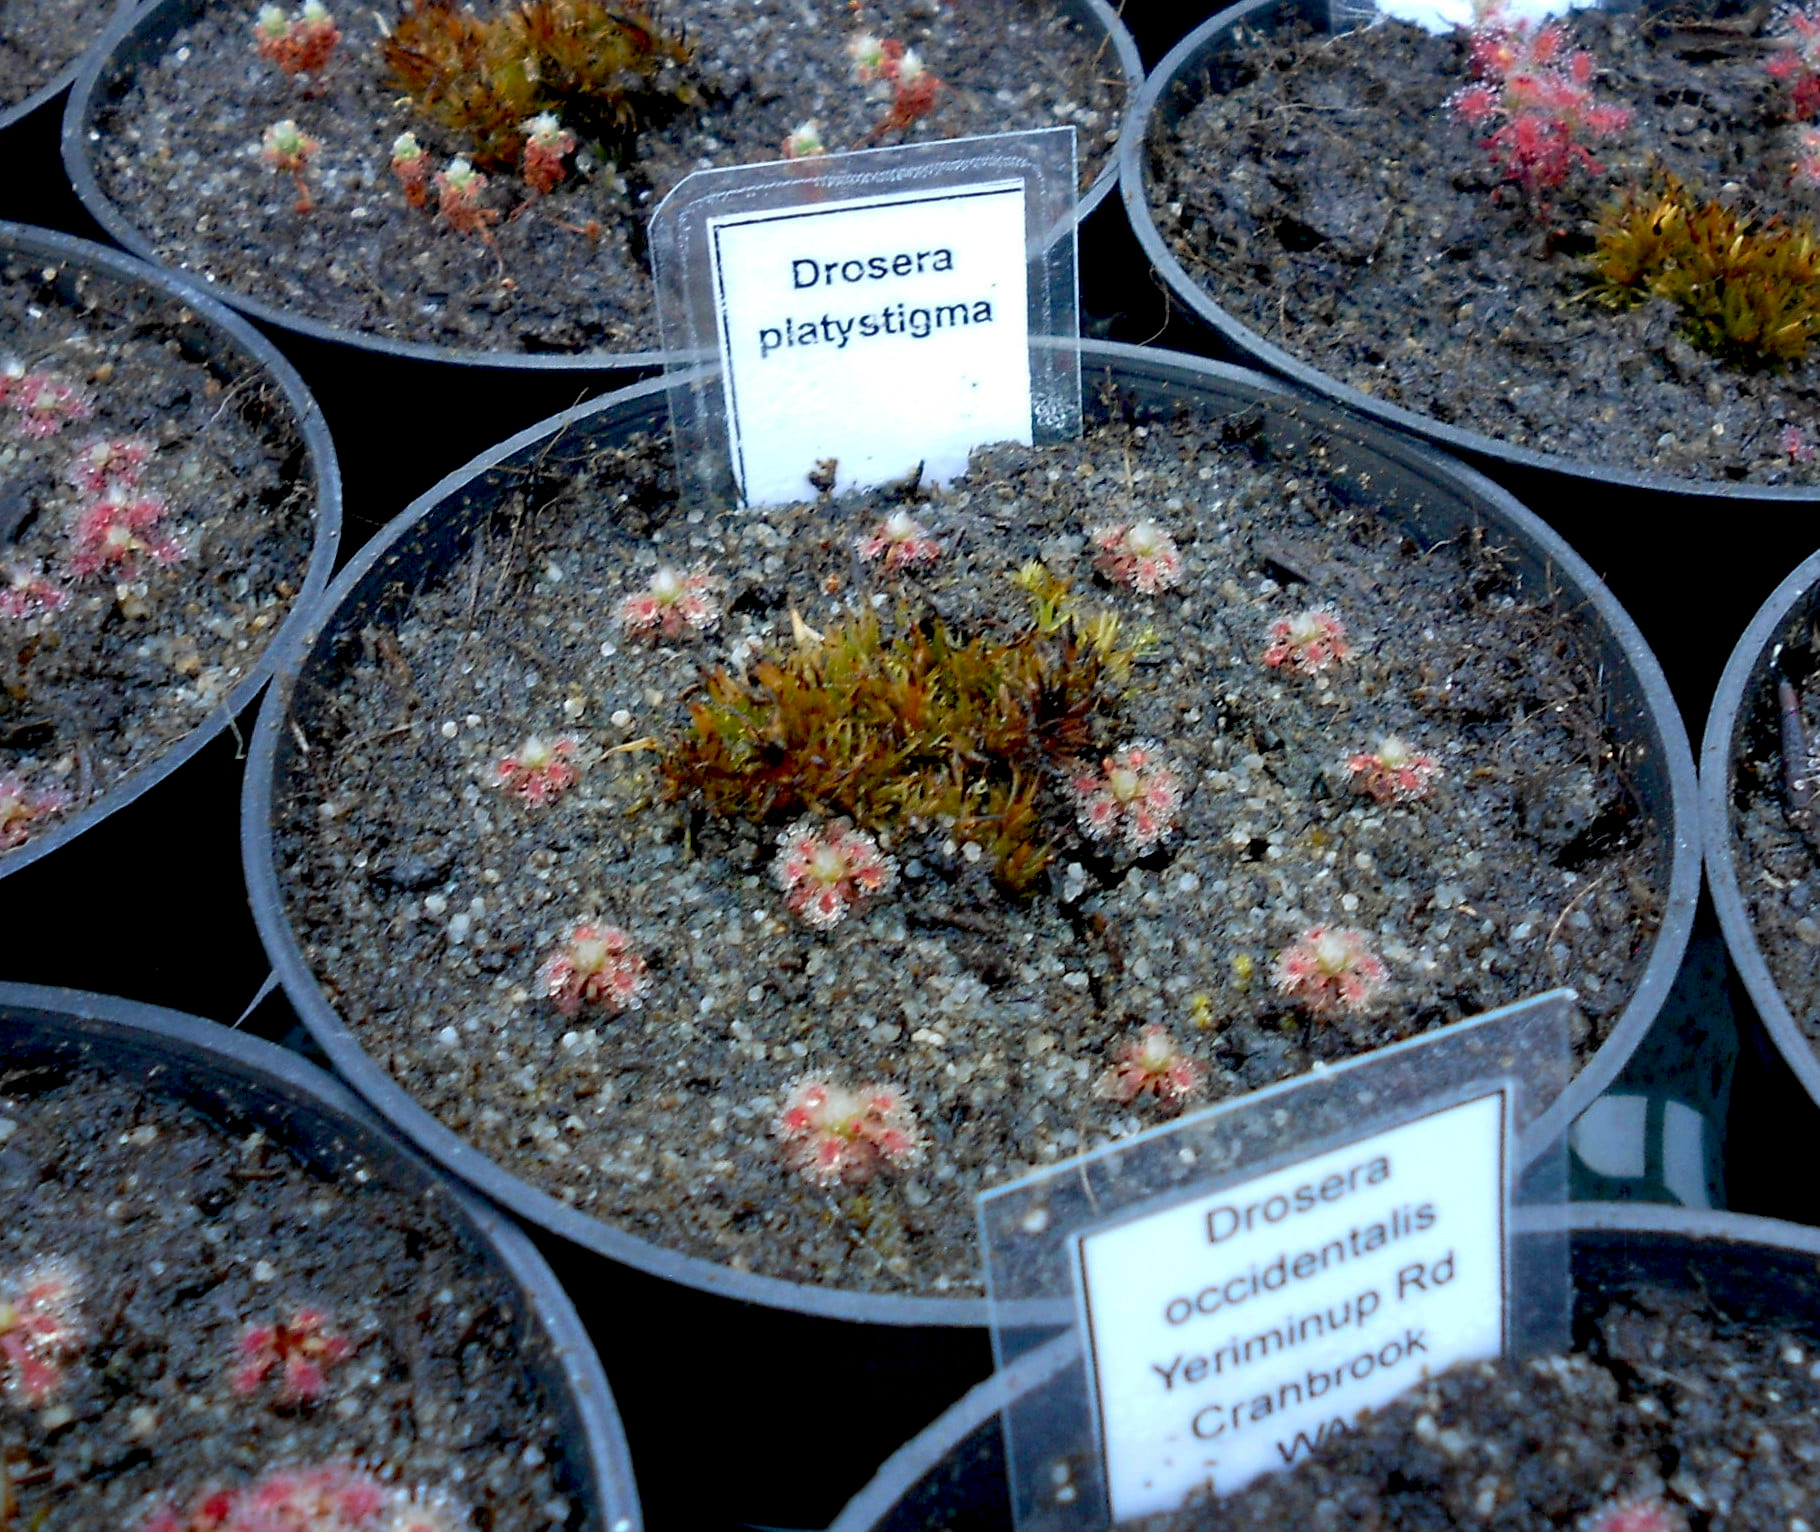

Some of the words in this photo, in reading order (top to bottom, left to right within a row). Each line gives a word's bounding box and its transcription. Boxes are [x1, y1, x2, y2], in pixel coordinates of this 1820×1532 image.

[791, 248, 954, 289] Drosera
[759, 300, 994, 359] platystigma
[1205, 1154, 1392, 1244] Drosera
[1165, 1201, 1438, 1326] occidentalis
[1152, 1289, 1380, 1390] Yeriminup
[1398, 1249, 1457, 1300] Rd
[1192, 1330, 1429, 1441] Cranbrook
